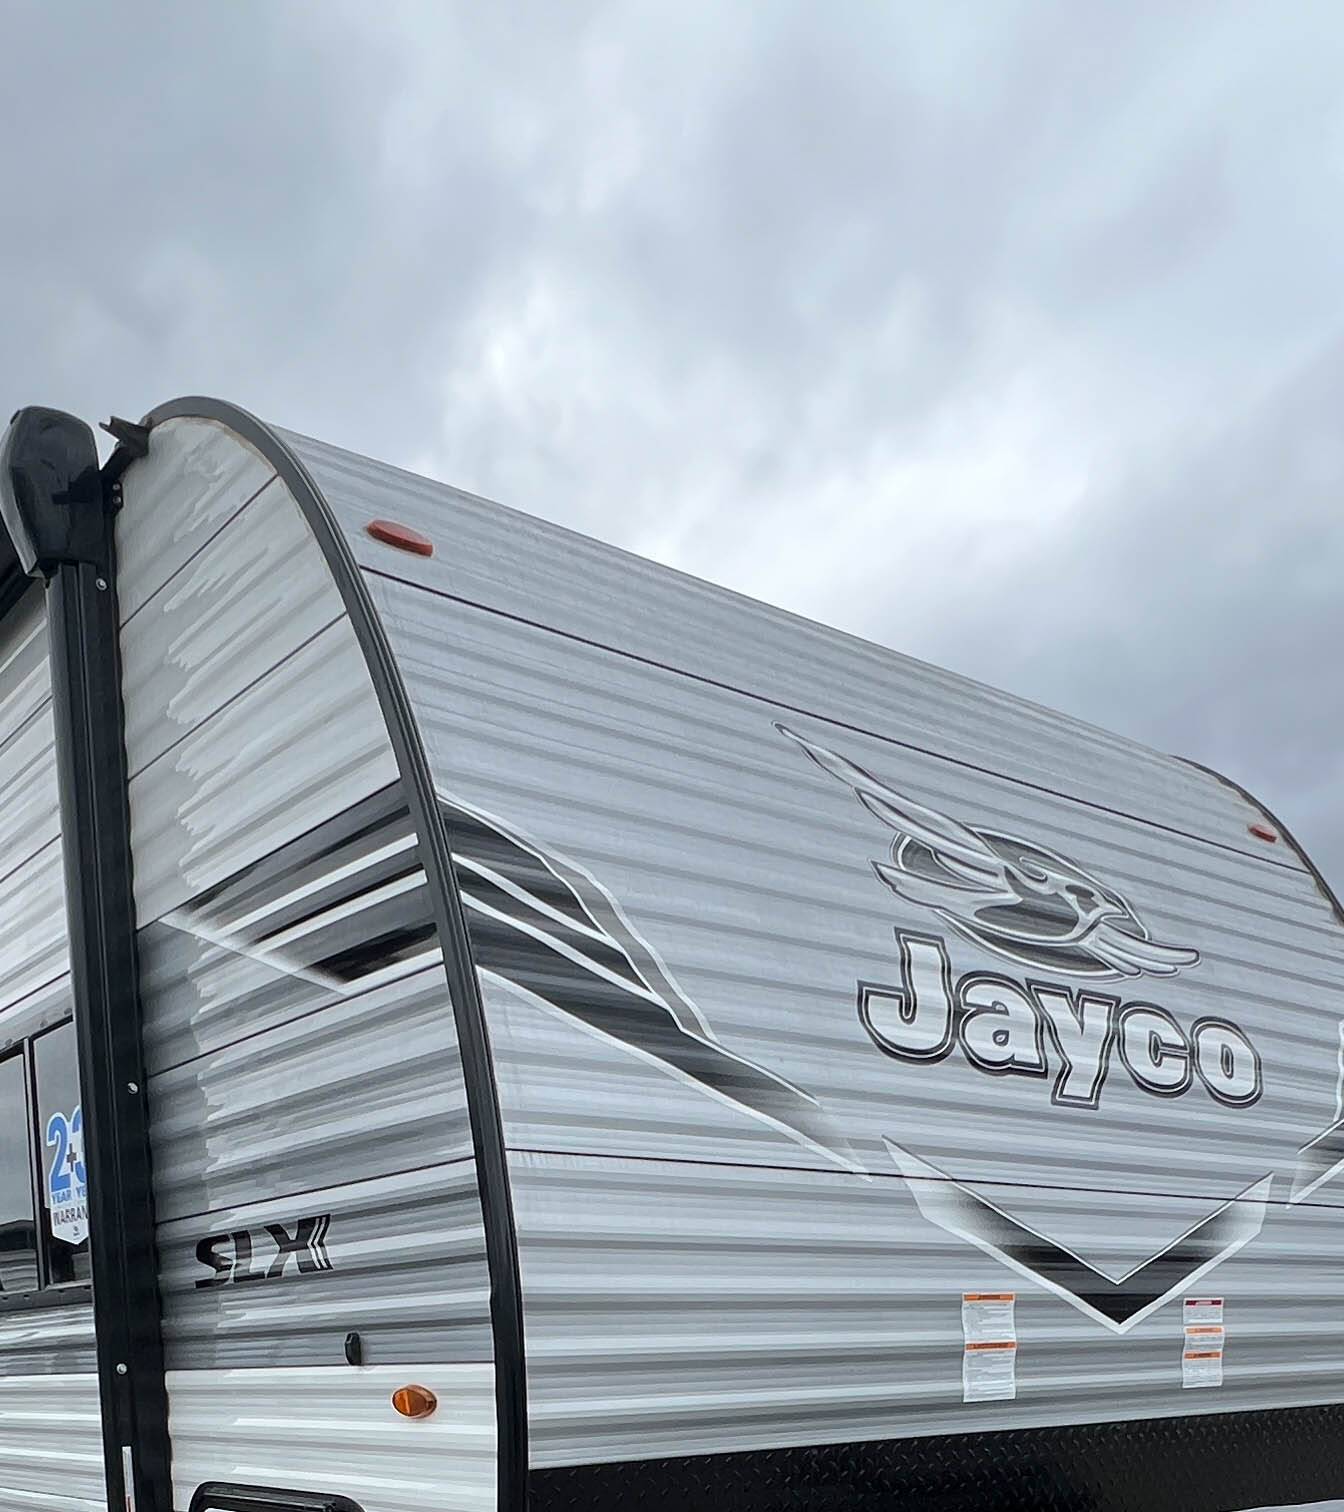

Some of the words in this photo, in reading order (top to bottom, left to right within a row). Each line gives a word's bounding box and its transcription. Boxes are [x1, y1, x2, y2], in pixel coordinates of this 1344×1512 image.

[857, 926, 1264, 1110] Jayco
[52, 1205, 88, 1226] WARRAN
[195, 1214, 333, 1289] SLX
